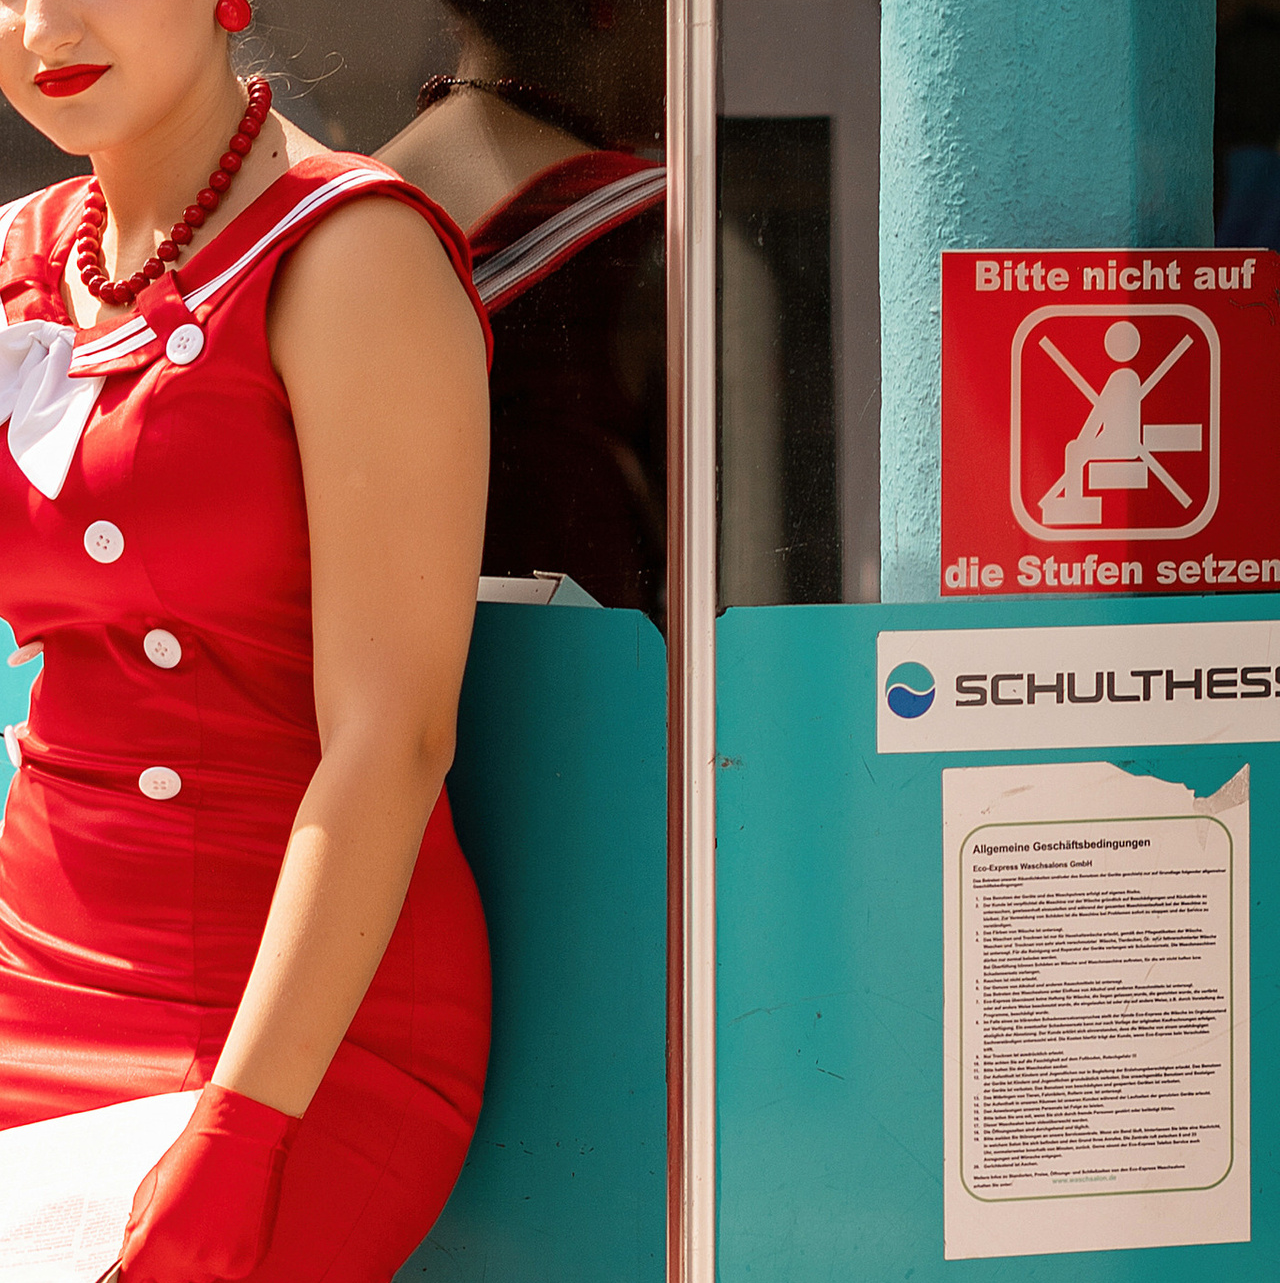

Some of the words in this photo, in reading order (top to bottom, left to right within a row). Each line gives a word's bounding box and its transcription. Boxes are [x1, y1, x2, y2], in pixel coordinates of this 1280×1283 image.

[975, 260, 1069, 292] Bitte
[1083, 259, 1181, 291] nicht
[1193, 258, 1256, 290] auf
[945, 557, 1004, 587] die
[1017, 555, 1142, 586] Stufen
[1157, 553, 1280, 584] setzen
[955, 666, 1280, 707] SCHULTHES
[972, 842, 1030, 856] Allgemeine
[1033, 838, 1151, 852] Geschäftsbedingungen
[972, 863, 1018, 873] Eco-Express
[1020, 861, 1068, 870] Waschsalons
[1069, 860, 1093, 868] GmbH
